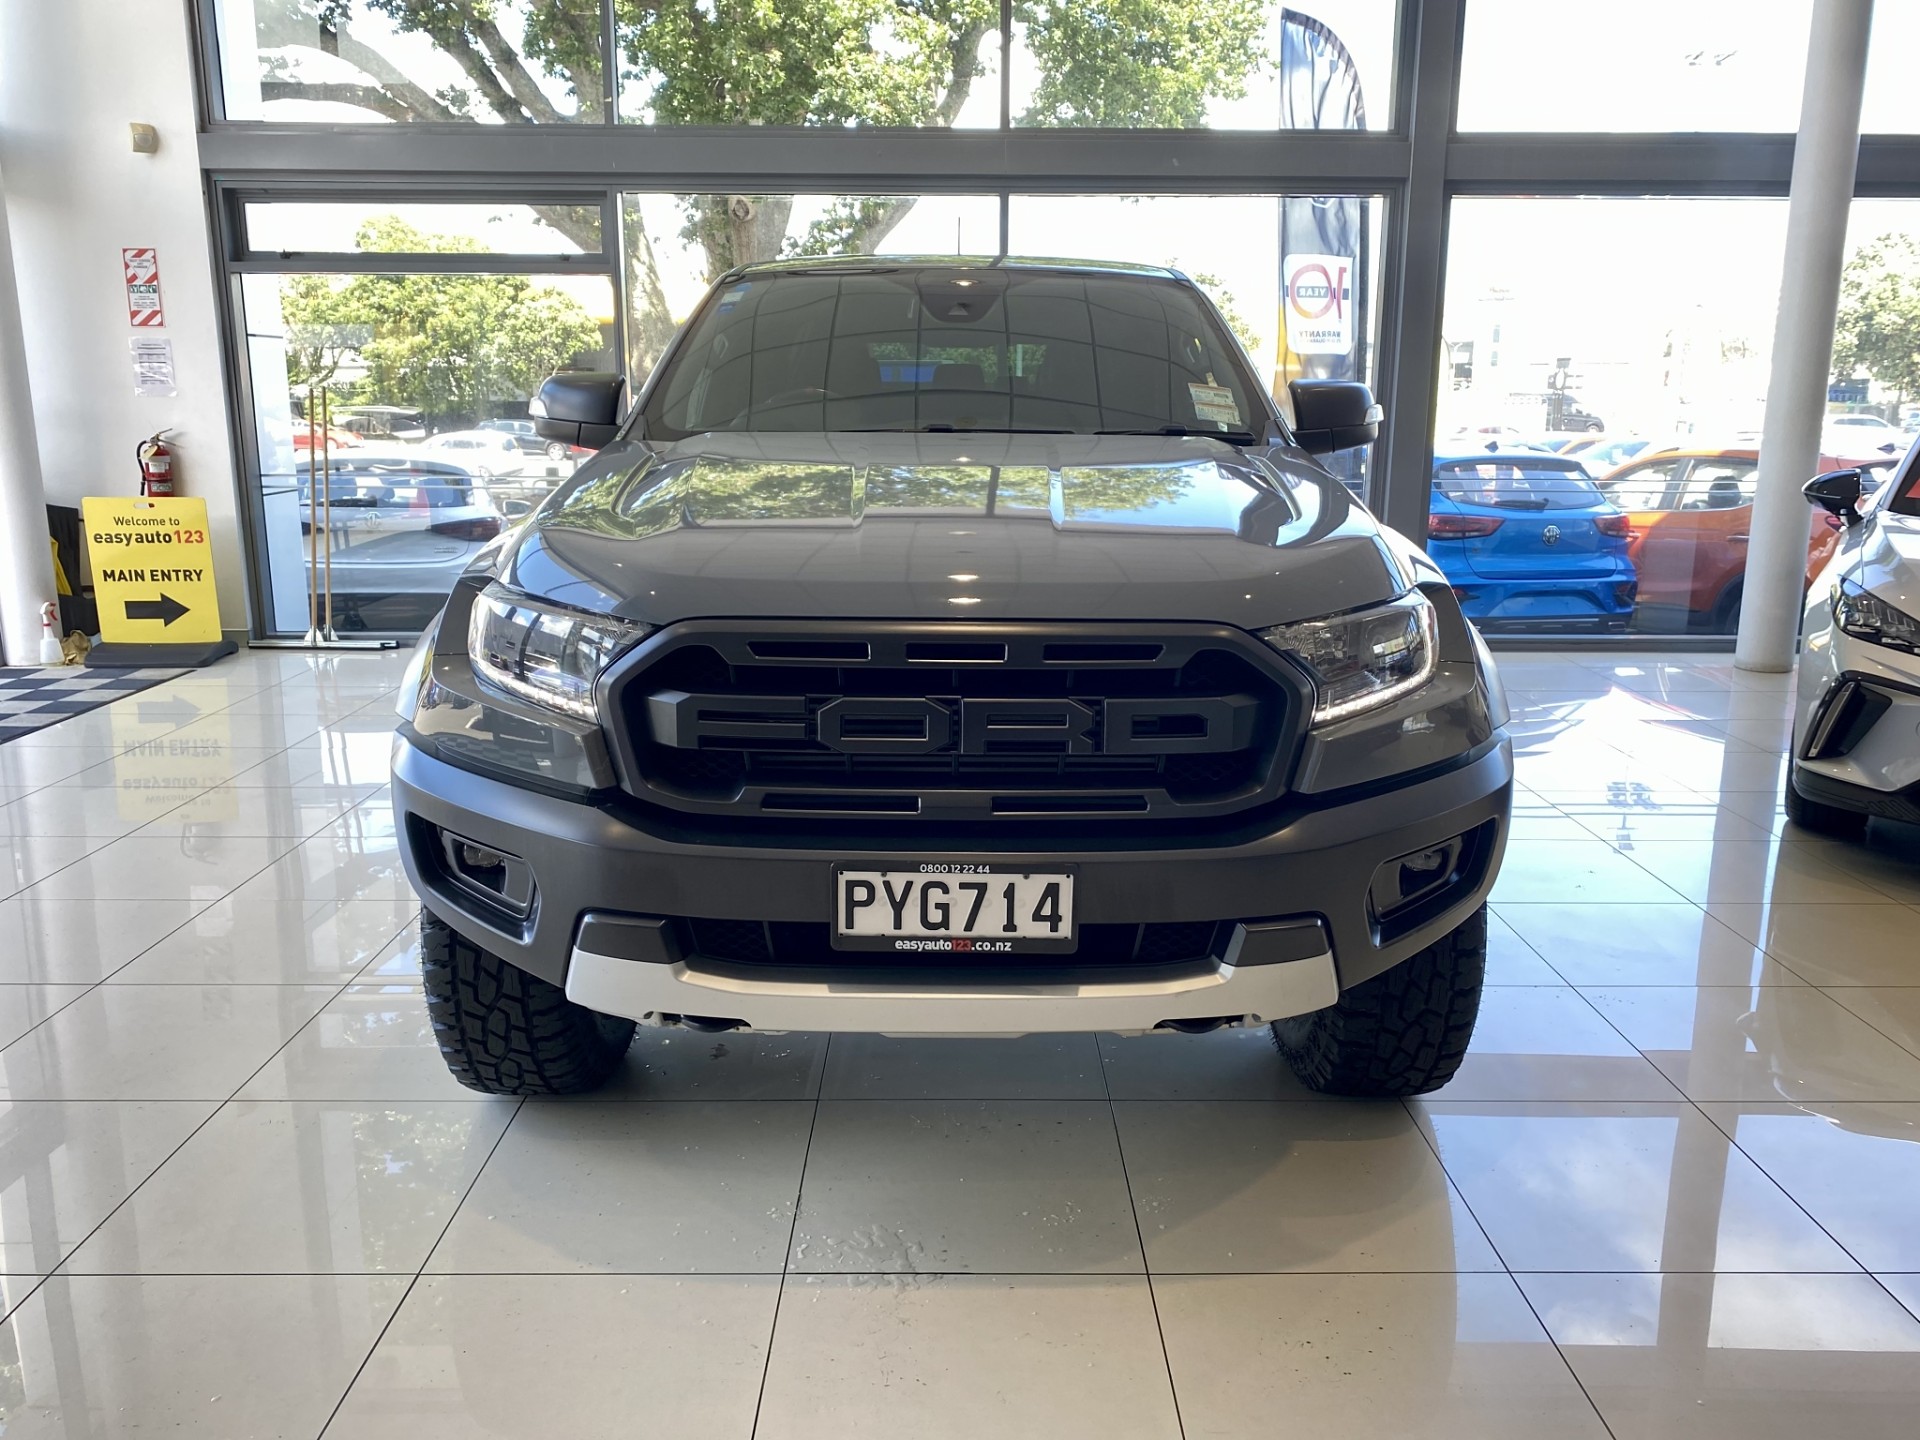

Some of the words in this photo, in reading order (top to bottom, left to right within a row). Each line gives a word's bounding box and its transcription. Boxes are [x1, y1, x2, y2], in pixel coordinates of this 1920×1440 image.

[113, 516, 166, 526] Welcome
[169, 517, 180, 526] to
[102, 569, 146, 582] MAIN
[150, 569, 204, 582] ENTRY
[648, 690, 1260, 754] FORD
[919, 863, 949, 873] 0800
[950, 864, 961, 874] 12
[962, 864, 975, 874] 22
[976, 865, 990, 874] 44
[845, 879, 1063, 933] PYG714
[895, 938, 1012, 951] easyauto123.co.nz
